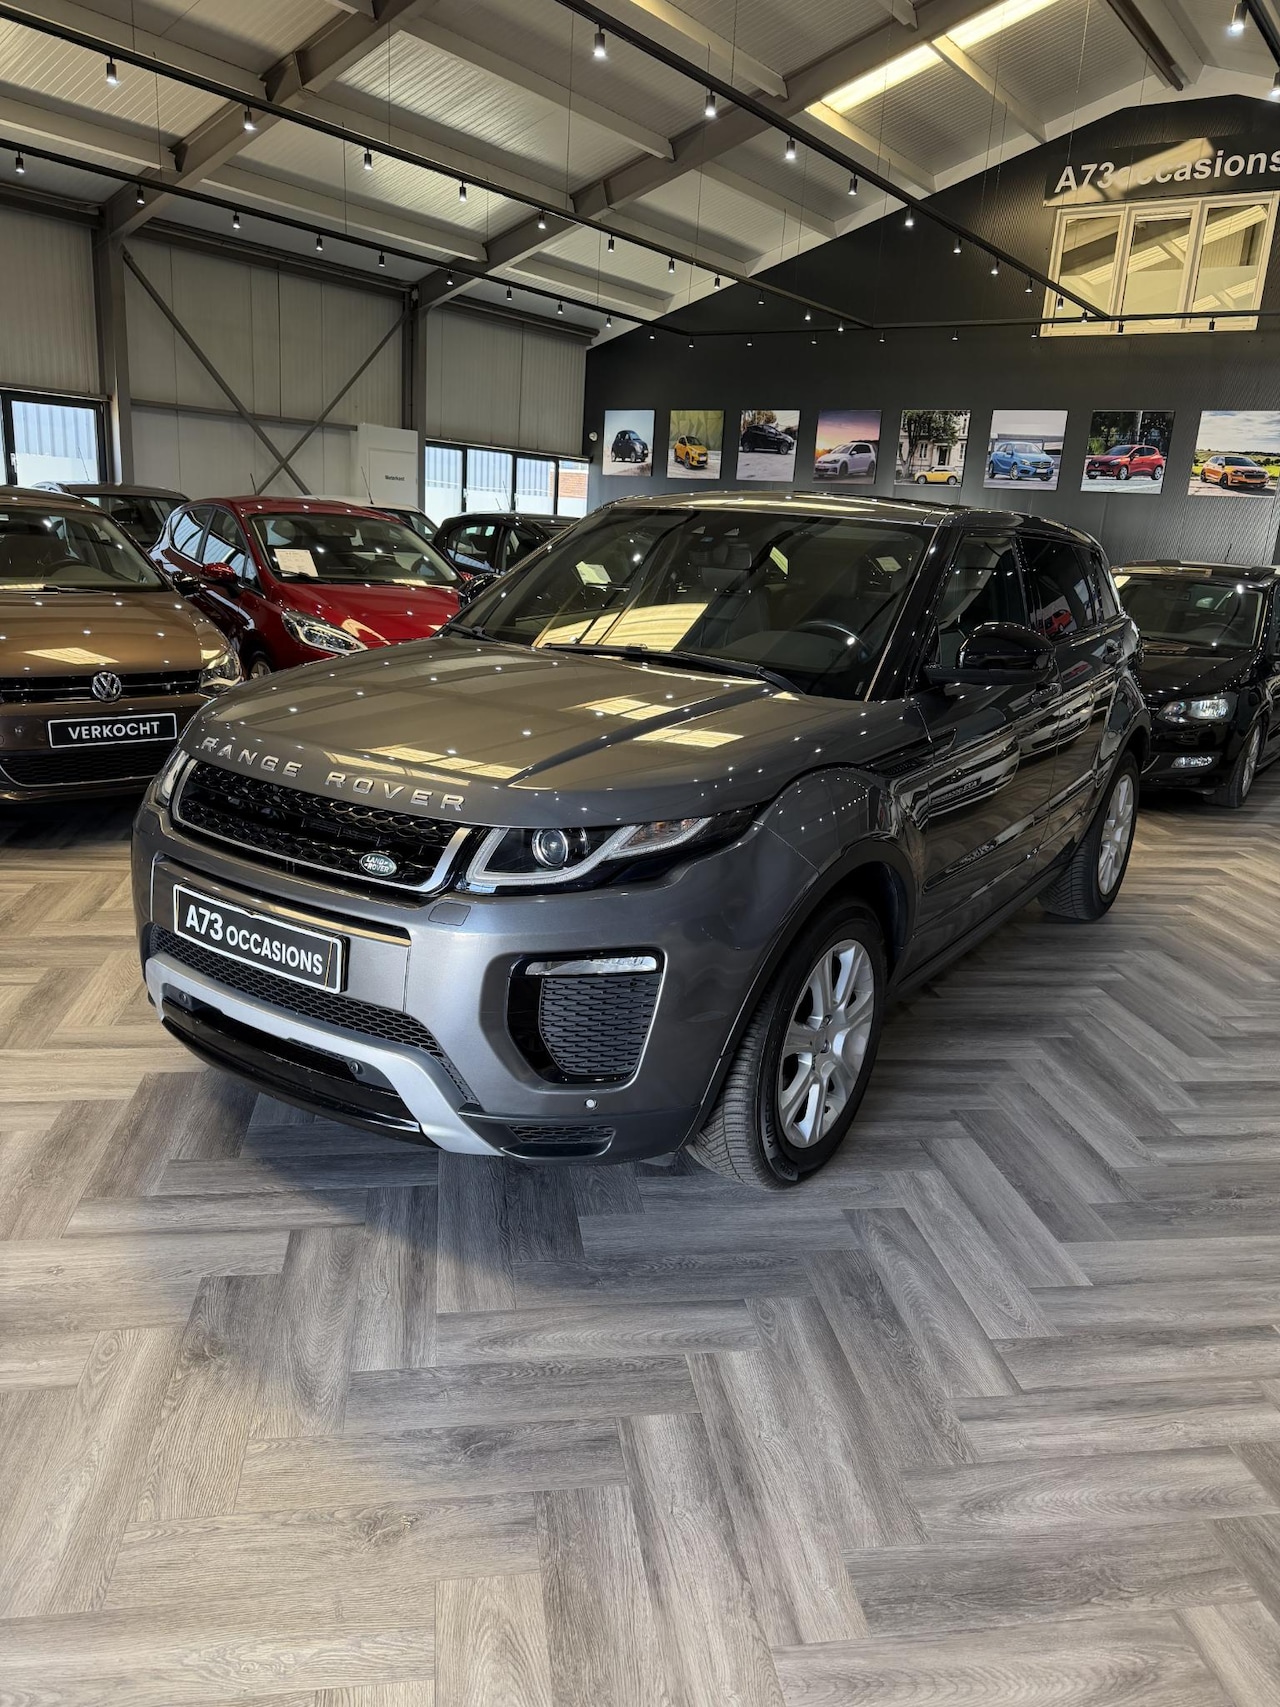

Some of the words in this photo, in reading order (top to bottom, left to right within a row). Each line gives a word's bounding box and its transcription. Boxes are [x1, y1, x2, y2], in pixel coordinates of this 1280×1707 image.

[68, 721, 160, 740] VERKOCHT
[201, 736, 303, 778] RANGE
[325, 771, 466, 811] ROVER
[366, 855, 385, 865] LAND
[367, 863, 390, 872] ROVER
[185, 904, 224, 941] A73
[226, 925, 323, 975] OCCASIONS
